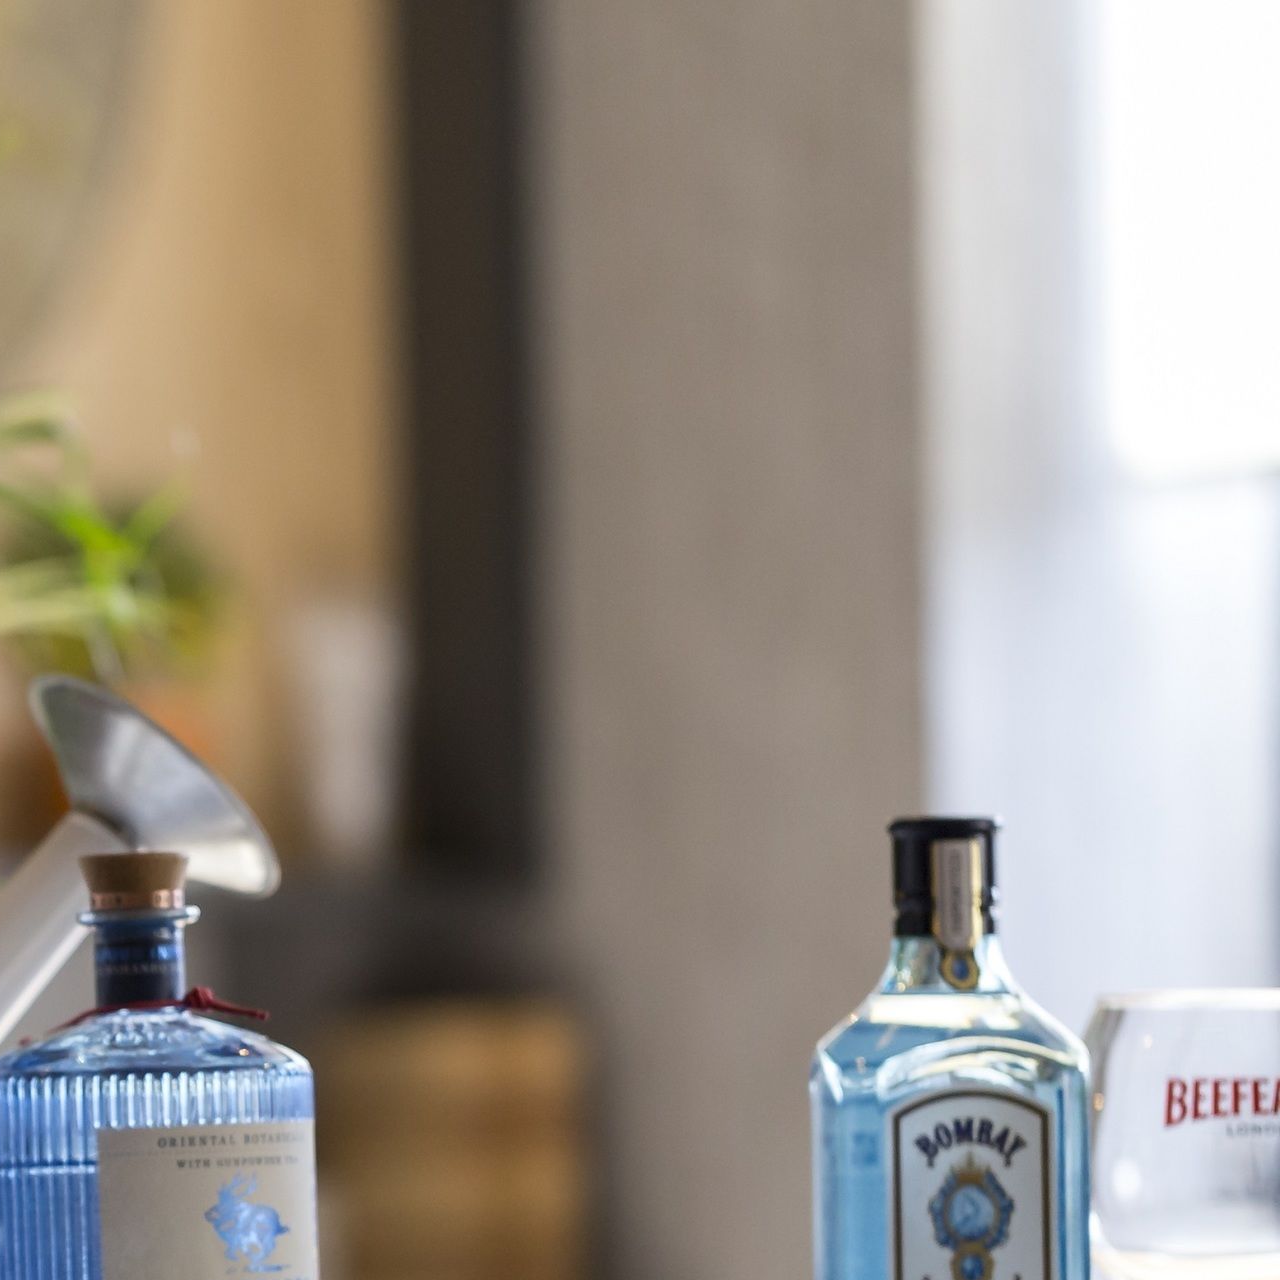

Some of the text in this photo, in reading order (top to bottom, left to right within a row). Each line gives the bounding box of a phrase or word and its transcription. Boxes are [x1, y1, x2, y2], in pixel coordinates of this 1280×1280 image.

[157, 1134, 237, 1149] ORIENTAL
[913, 1116, 1027, 1168] BOMBAY
[176, 1158, 211, 1169] WITH
